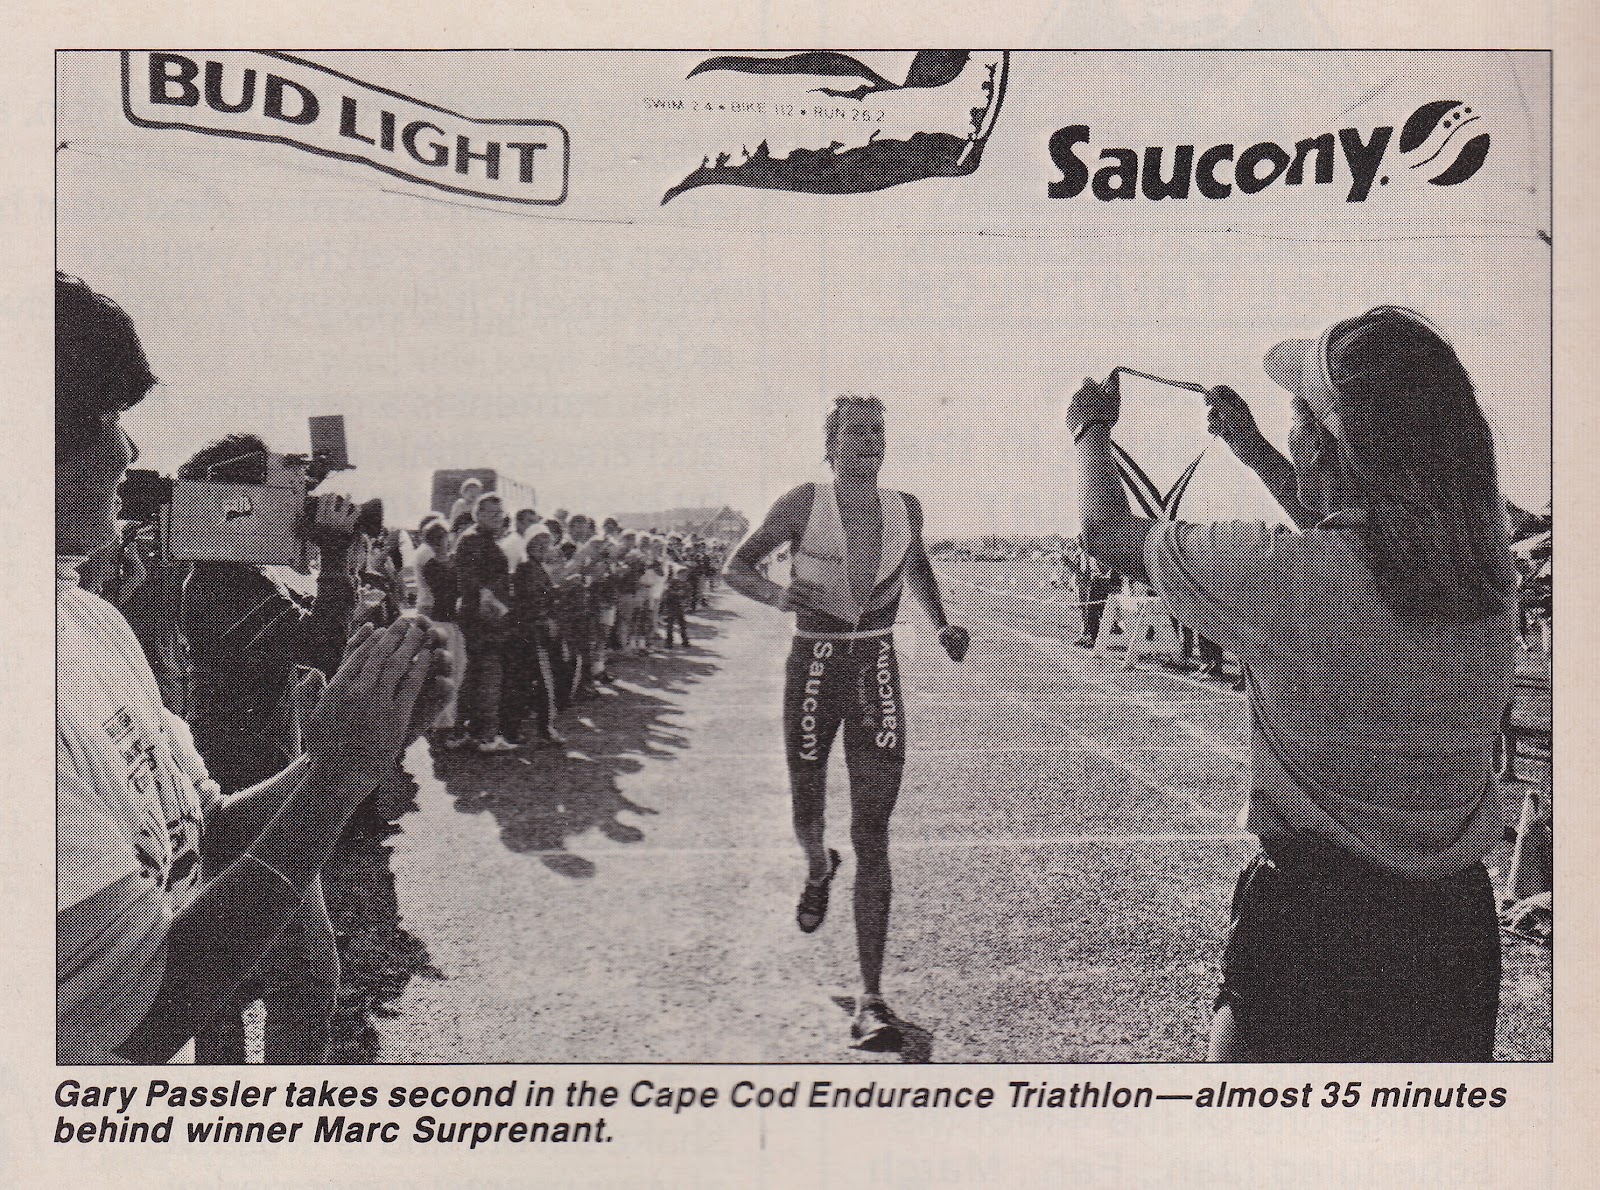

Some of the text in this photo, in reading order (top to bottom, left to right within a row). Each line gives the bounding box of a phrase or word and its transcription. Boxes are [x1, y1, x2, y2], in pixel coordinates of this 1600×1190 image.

[148, 52, 547, 184] BUD LIGHT
[643, 97, 685, 111] SWIM
[730, 101, 767, 113] BIKE
[814, 105, 846, 119] RUN
[800, 641, 834, 762] Saucony
[875, 640, 899, 750] Saucony
